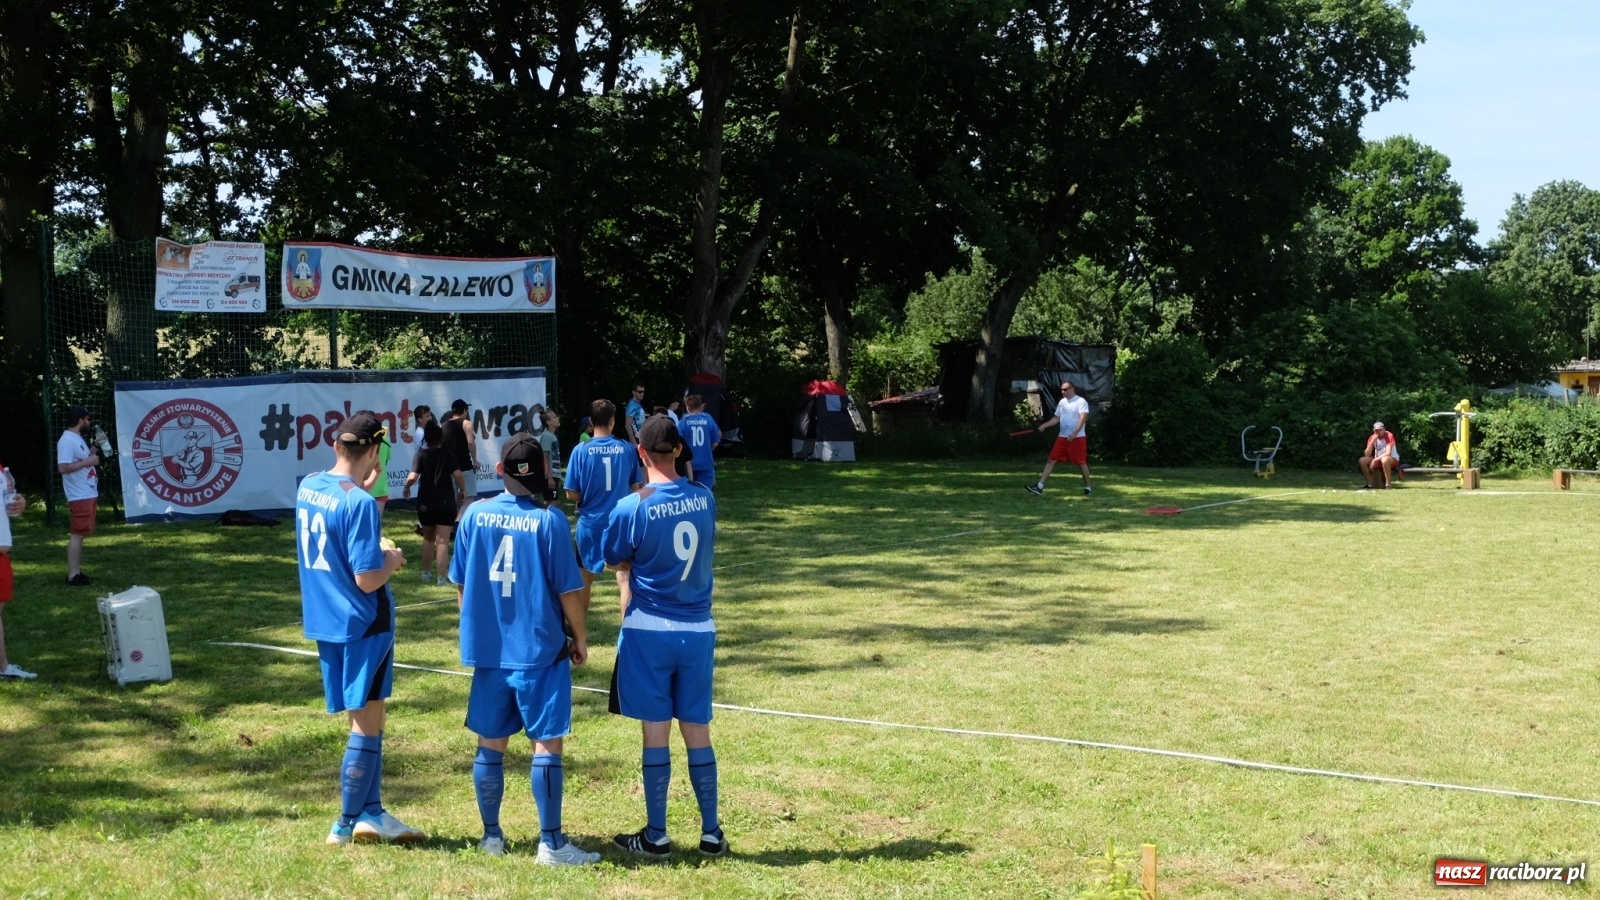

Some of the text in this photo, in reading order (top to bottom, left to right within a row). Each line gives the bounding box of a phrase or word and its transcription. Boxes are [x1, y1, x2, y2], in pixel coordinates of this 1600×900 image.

[331, 264, 514, 297] GMINA ZALEWO
[141, 403, 233, 438] POLSKIE STOWARZYSZENIE
[691, 426, 704, 447] 10
[588, 444, 625, 455] CYPRZANÓW
[146, 471, 233, 503] PALANTOWE
[601, 457, 612, 491] 1
[298, 487, 340, 512] CYPRZANÓW
[552, 490, 558, 498] 7
[648, 494, 708, 520] CYPRZANÓW
[476, 512, 540, 533] CYPRZANÓW
[298, 508, 331, 572] 12
[673, 520, 699, 582] 9
[489, 535, 516, 597] 4
